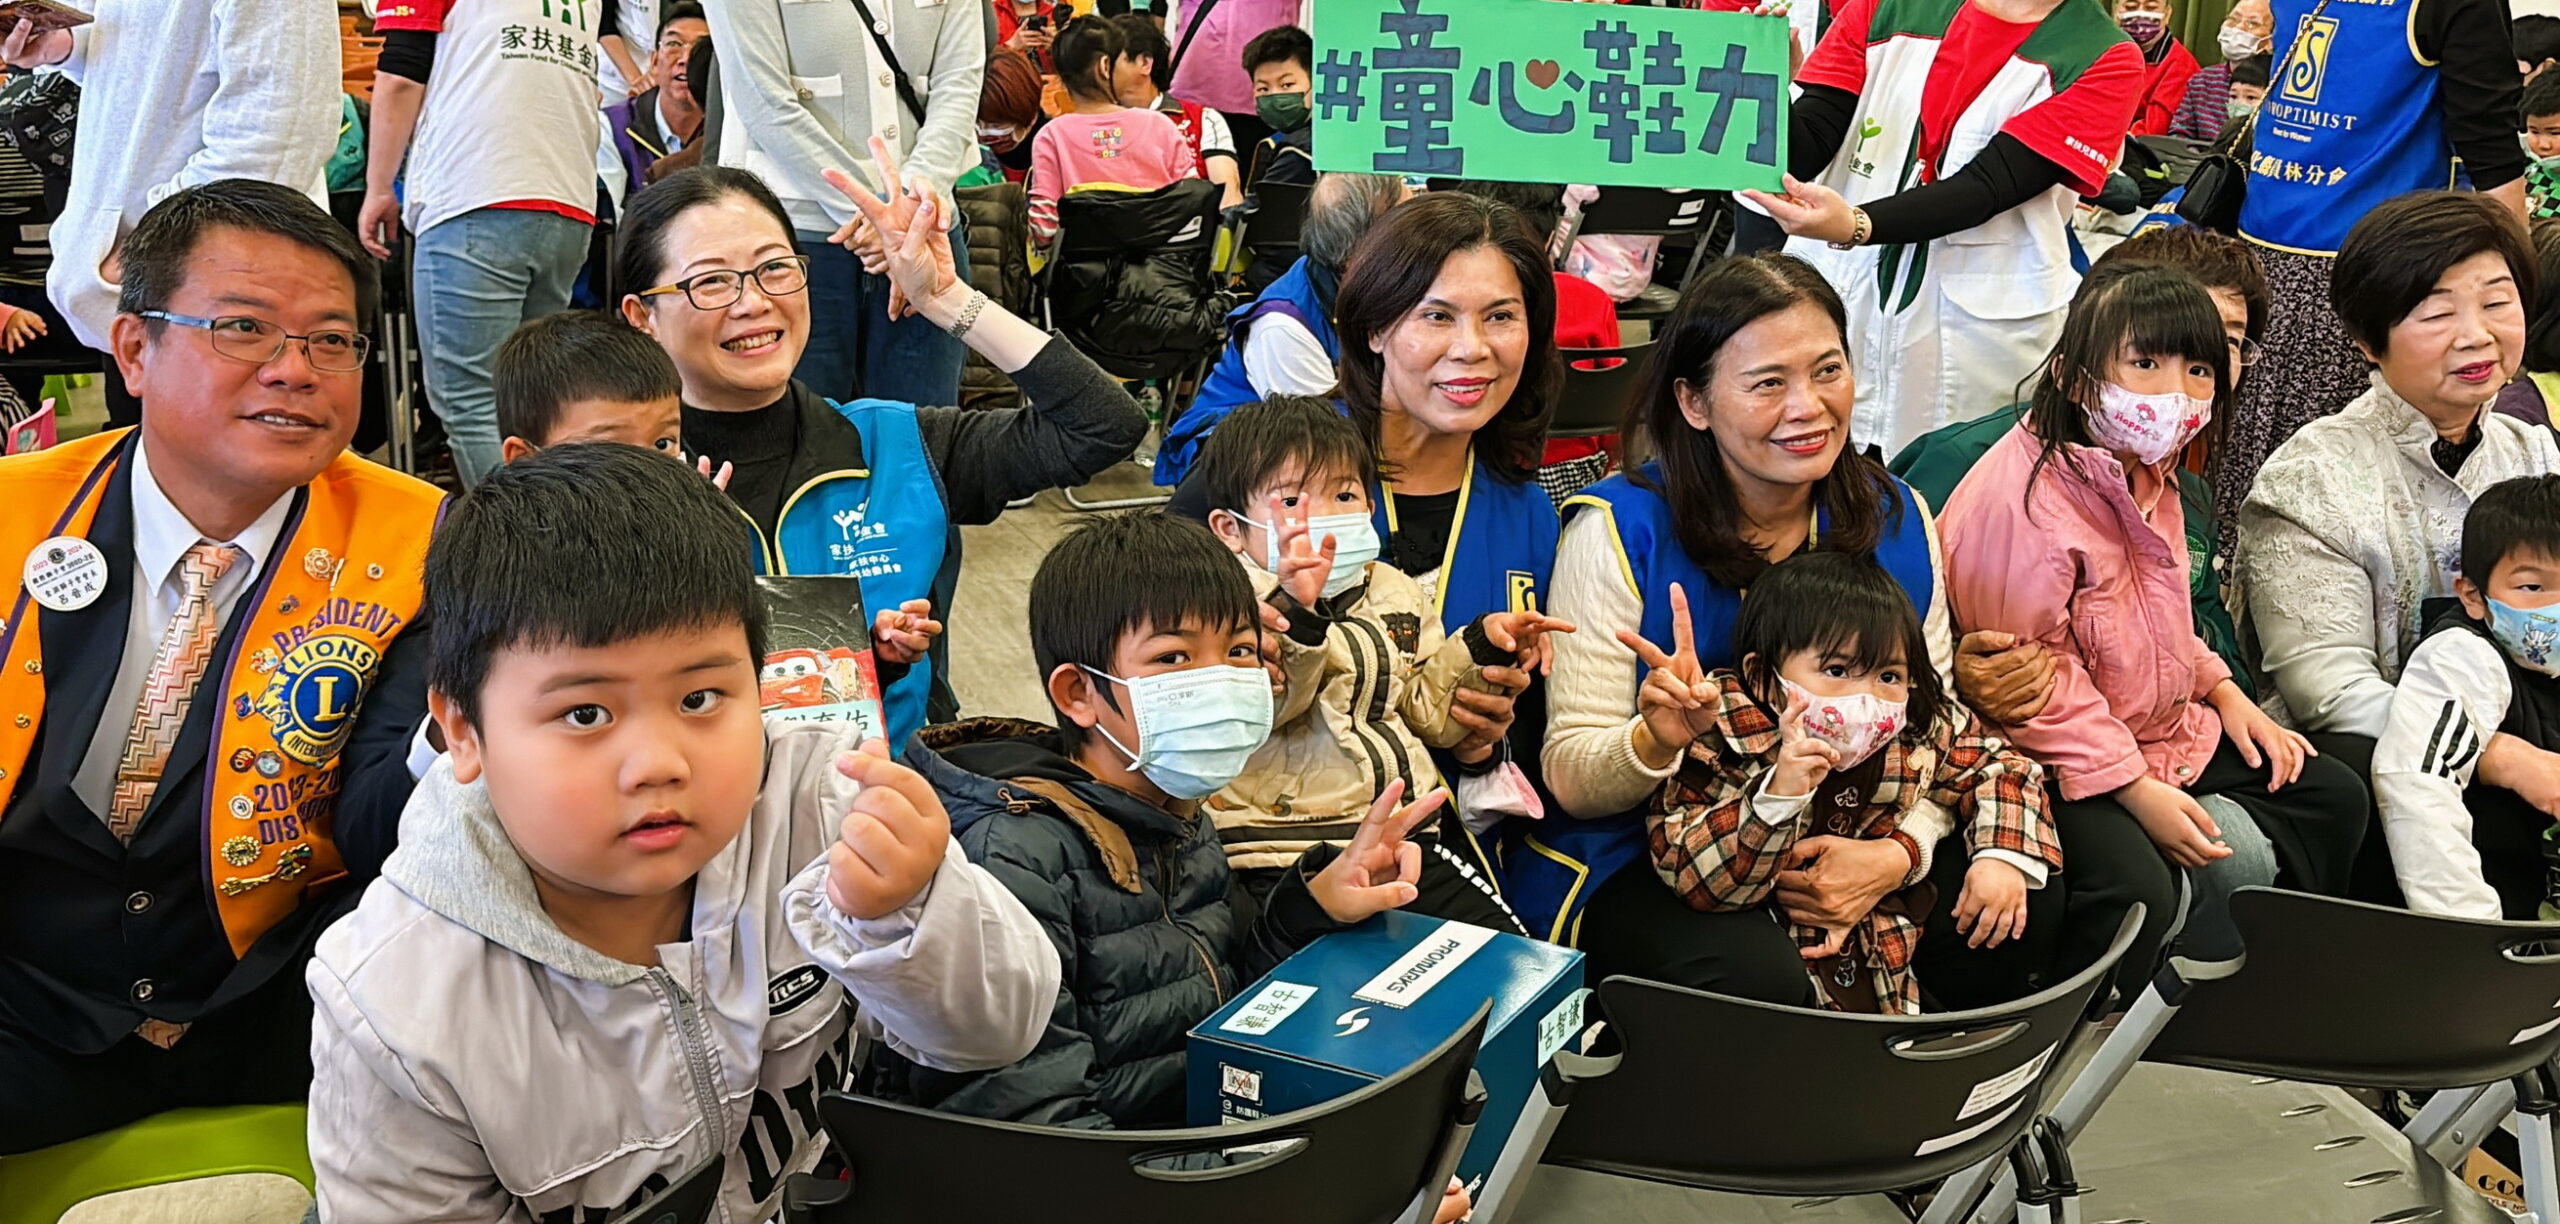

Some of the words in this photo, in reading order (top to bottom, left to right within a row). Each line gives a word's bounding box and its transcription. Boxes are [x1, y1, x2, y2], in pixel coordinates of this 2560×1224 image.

[502, 24, 598, 73] 家扶基金
[1316, 0, 1779, 176] #童心鞋力
[273, 598, 401, 656] PRESIDENT
[292, 640, 373, 669] LIONS
[314, 676, 346, 722] L
